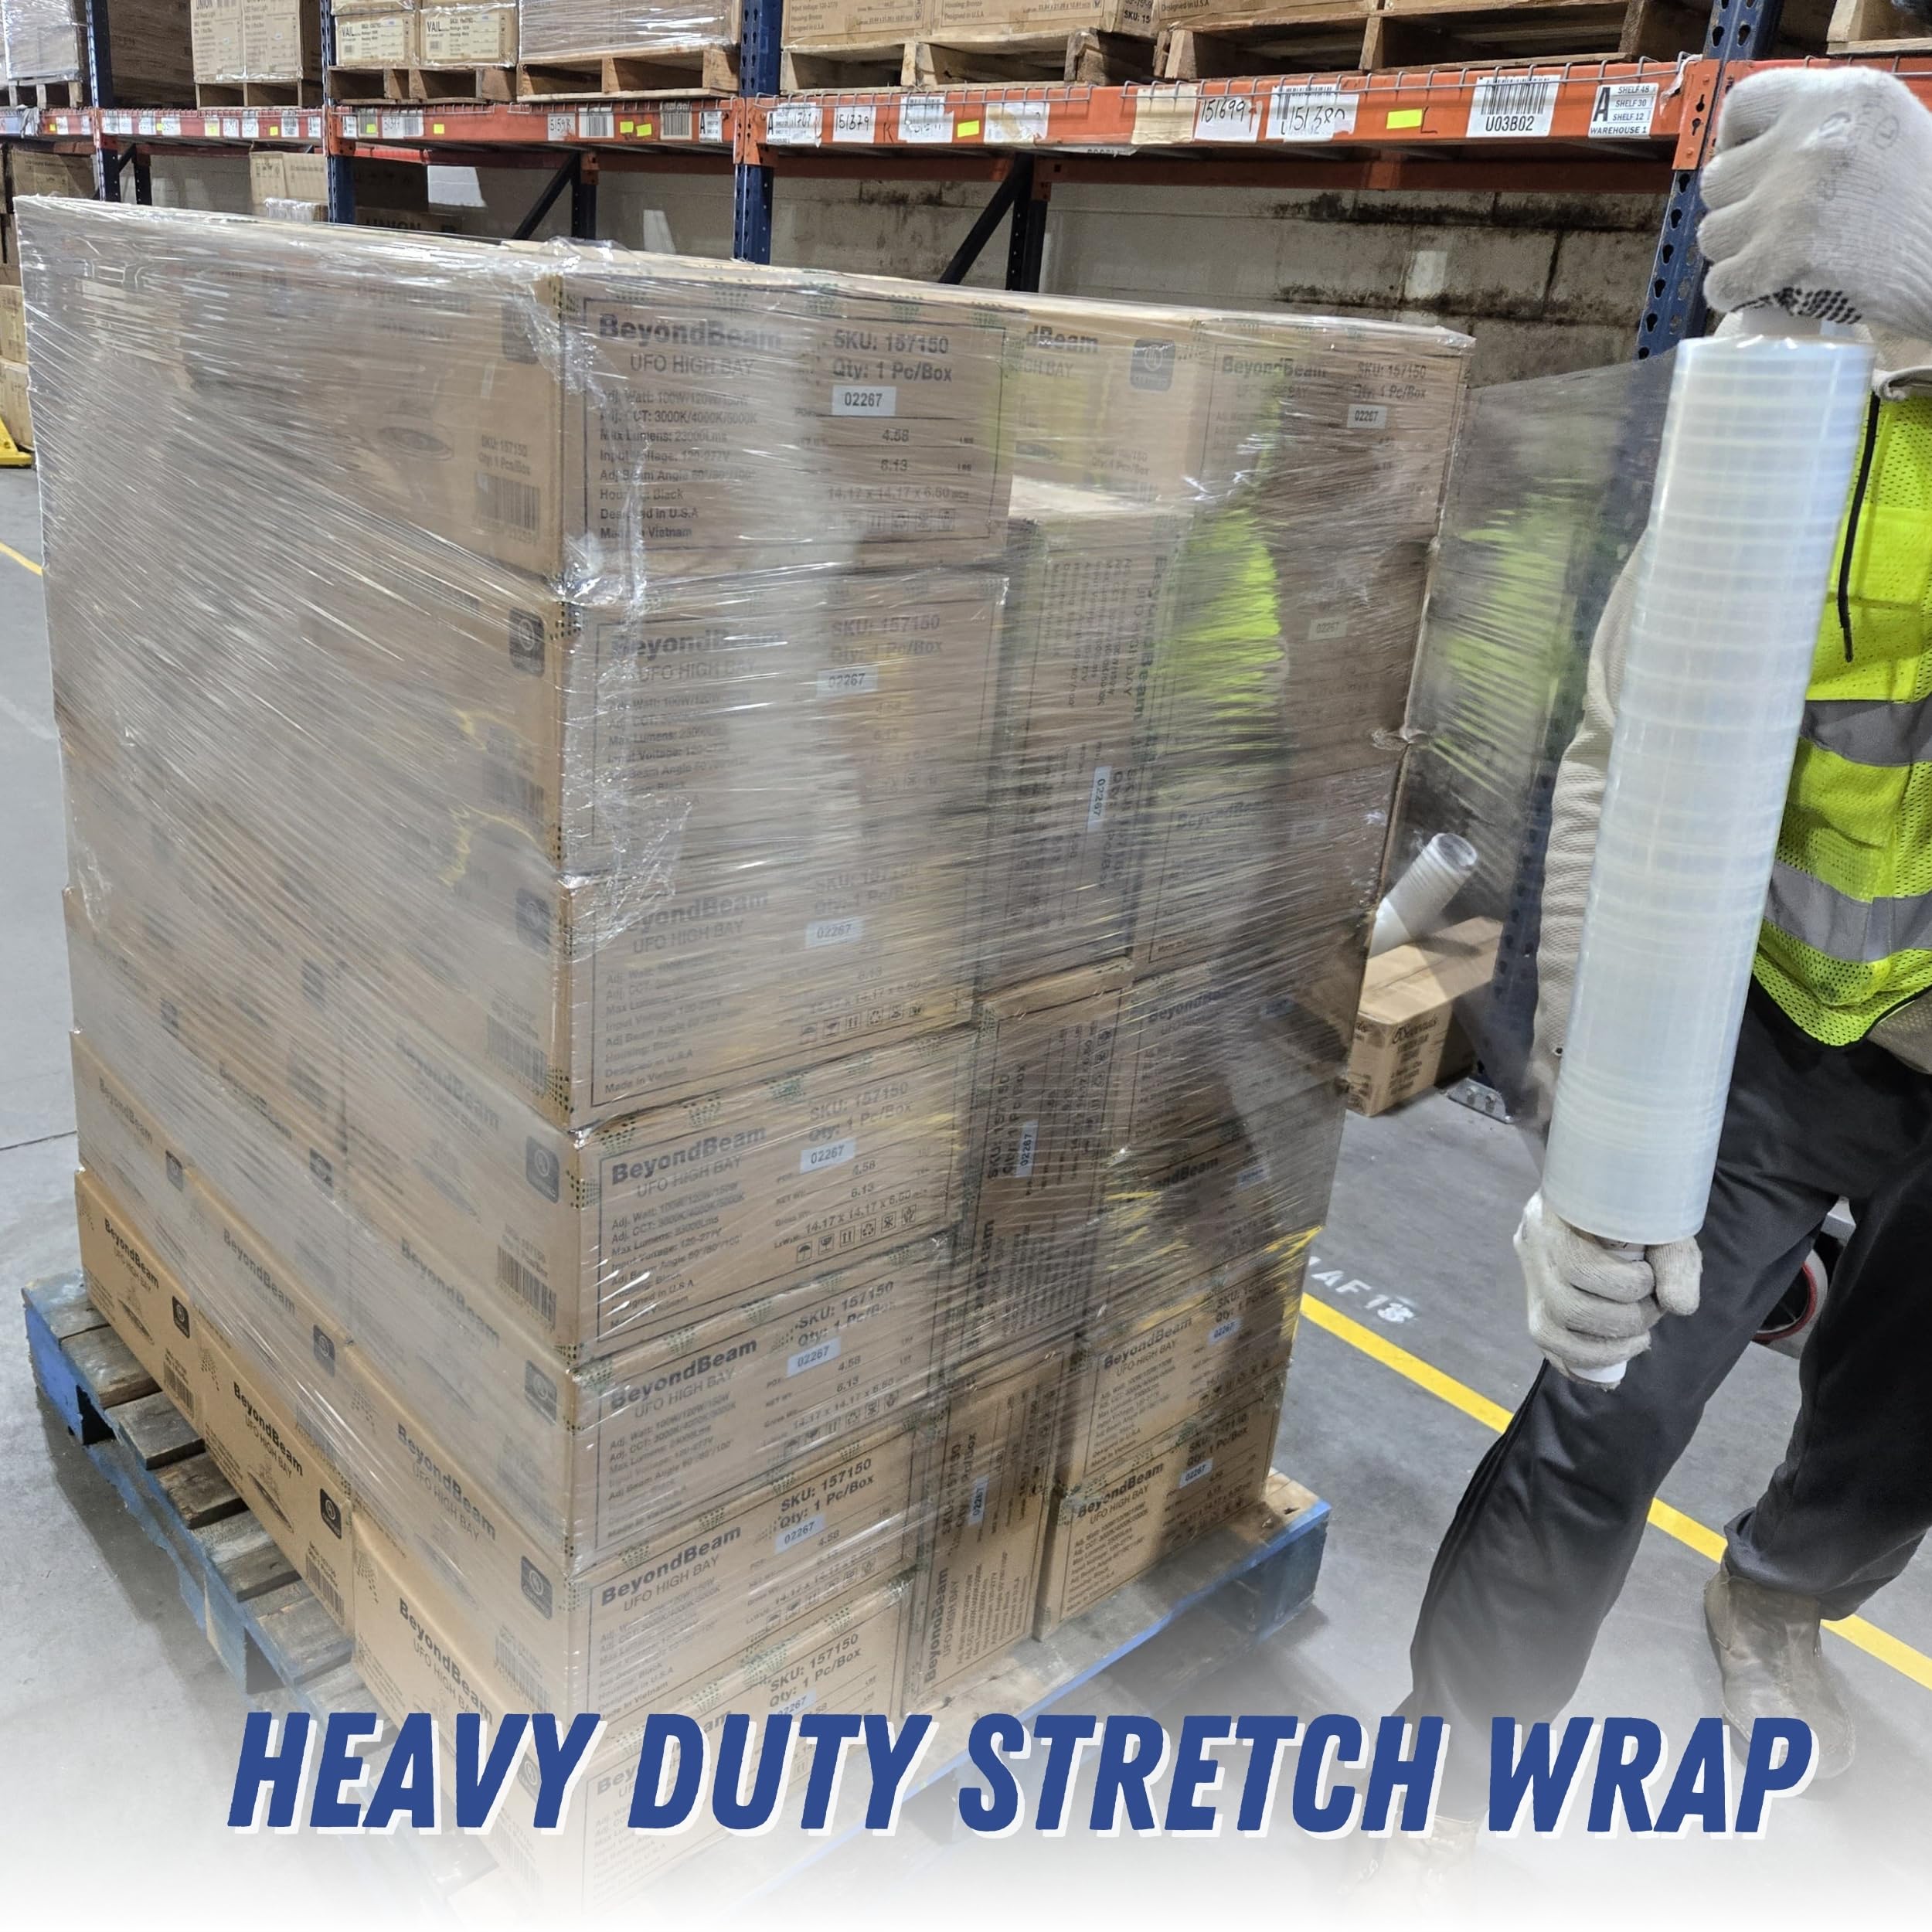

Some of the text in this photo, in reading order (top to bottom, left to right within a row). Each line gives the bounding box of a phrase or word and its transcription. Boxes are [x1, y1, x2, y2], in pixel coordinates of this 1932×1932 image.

[427, 21, 441, 32] VAIL
[1593, 87, 1611, 121] A
[768, 113, 773, 134] A
[1485, 114, 1533, 132] U03B02
[600, 314, 781, 348] BeyondBeam
[833, 329, 877, 351] SKU:
[630, 354, 665, 372] UFO
[832, 358, 952, 382] Qty: 1 Pc/Box
[844, 392, 883, 406] 02267
[1354, 410, 1379, 422] 02267
[828, 672, 866, 689] 02267
[1093, 777, 1107, 818] 02267
[811, 1083, 909, 1121] SKU: 157150
[612, 1127, 767, 1185] BeyondBeam
[811, 1145, 845, 1164] 02267
[637, 1179, 668, 1198] UFO
[104, 1218, 159, 1289] BeyondBeam
[223, 1229, 298, 1315] BeyondBeam
[798, 1281, 893, 1329] SKU: 157150
[798, 1327, 828, 1347] Qty:
[1104, 1318, 1192, 1370] BeyondBeam
[1213, 1321, 1236, 1338] 02267
[610, 1339, 757, 1410] BeyondBeam
[798, 1345, 829, 1368] 02267
[838, 1355, 862, 1372] 4.58
[634, 1399, 664, 1418] UFO
[668, 1382, 703, 1405] HIGH
[836, 1376, 859, 1393] 6.13
[233, 1381, 303, 1476] BeyondBeam
[260, 1433, 277, 1461] HIGH
[278, 1458, 292, 1478] BAY
[1185, 1464, 1206, 1481] 02267
[397, 1422, 496, 1540] BeyondBeam
[781, 1458, 872, 1512] SKU: 157150
[1077, 1464, 1164, 1519] BeyondBeam
[434, 1486, 457, 1518] HIGH
[460, 1514, 479, 1540] BAY
[779, 1509, 808, 1530] Qty:
[826, 1476, 874, 1506] Pc/Box
[1090, 1485, 1149, 1524] UFO HIGH BAY
[784, 1522, 815, 1544] 02267
[601, 1527, 741, 1607] BeyondBeam
[623, 1555, 719, 1611] UFO HIGH BAY
[924, 1568, 949, 1682] BeyondBeam
[400, 1597, 493, 1726] BeyondBeam
[413, 1637, 432, 1668] UFO
[770, 1633, 859, 1692] SKU: 157150
[770, 1648, 862, 1708] Qty: 1 Pc/Box
